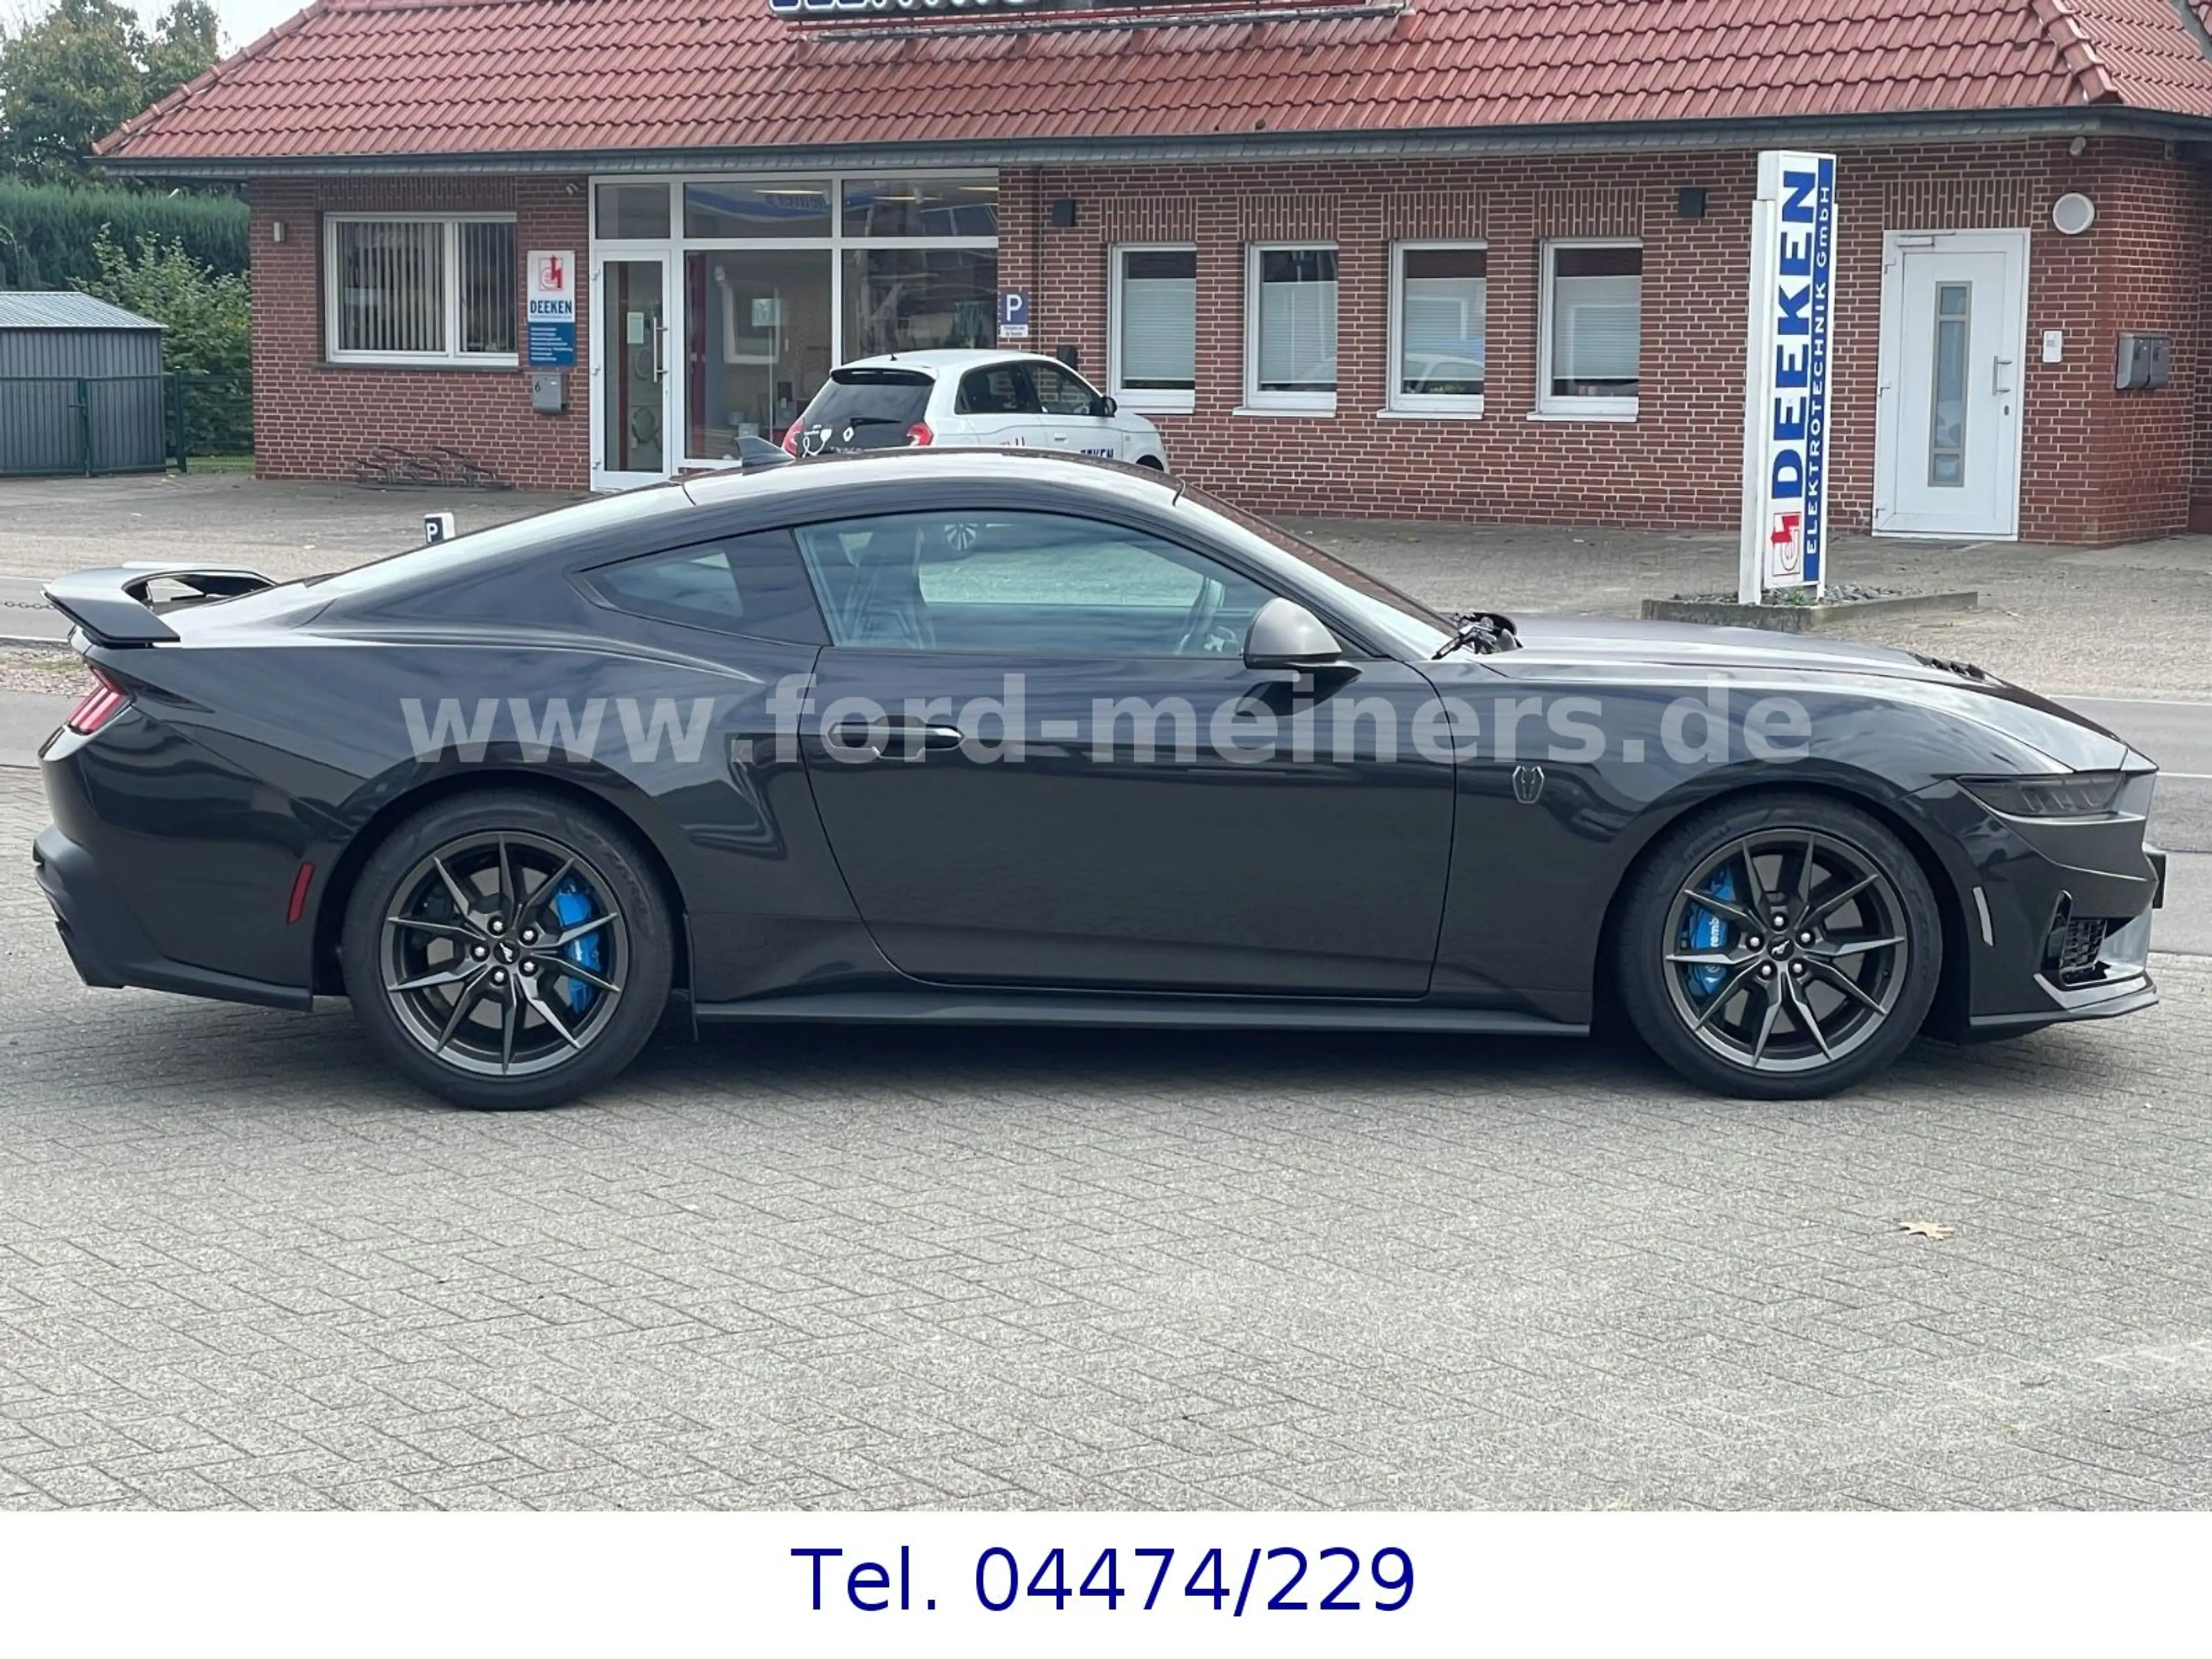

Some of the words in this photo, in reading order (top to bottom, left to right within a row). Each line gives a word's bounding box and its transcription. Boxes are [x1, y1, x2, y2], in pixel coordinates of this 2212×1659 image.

[530, 300, 572, 314] DEEKEN
[1006, 293, 1022, 321] P
[1771, 171, 1816, 498] DEEKEN
[1806, 282, 1826, 554] ELEKTROTECHNIK
[1816, 187, 1830, 267] GmbH
[535, 380, 541, 393] 6
[426, 522, 438, 542] P
